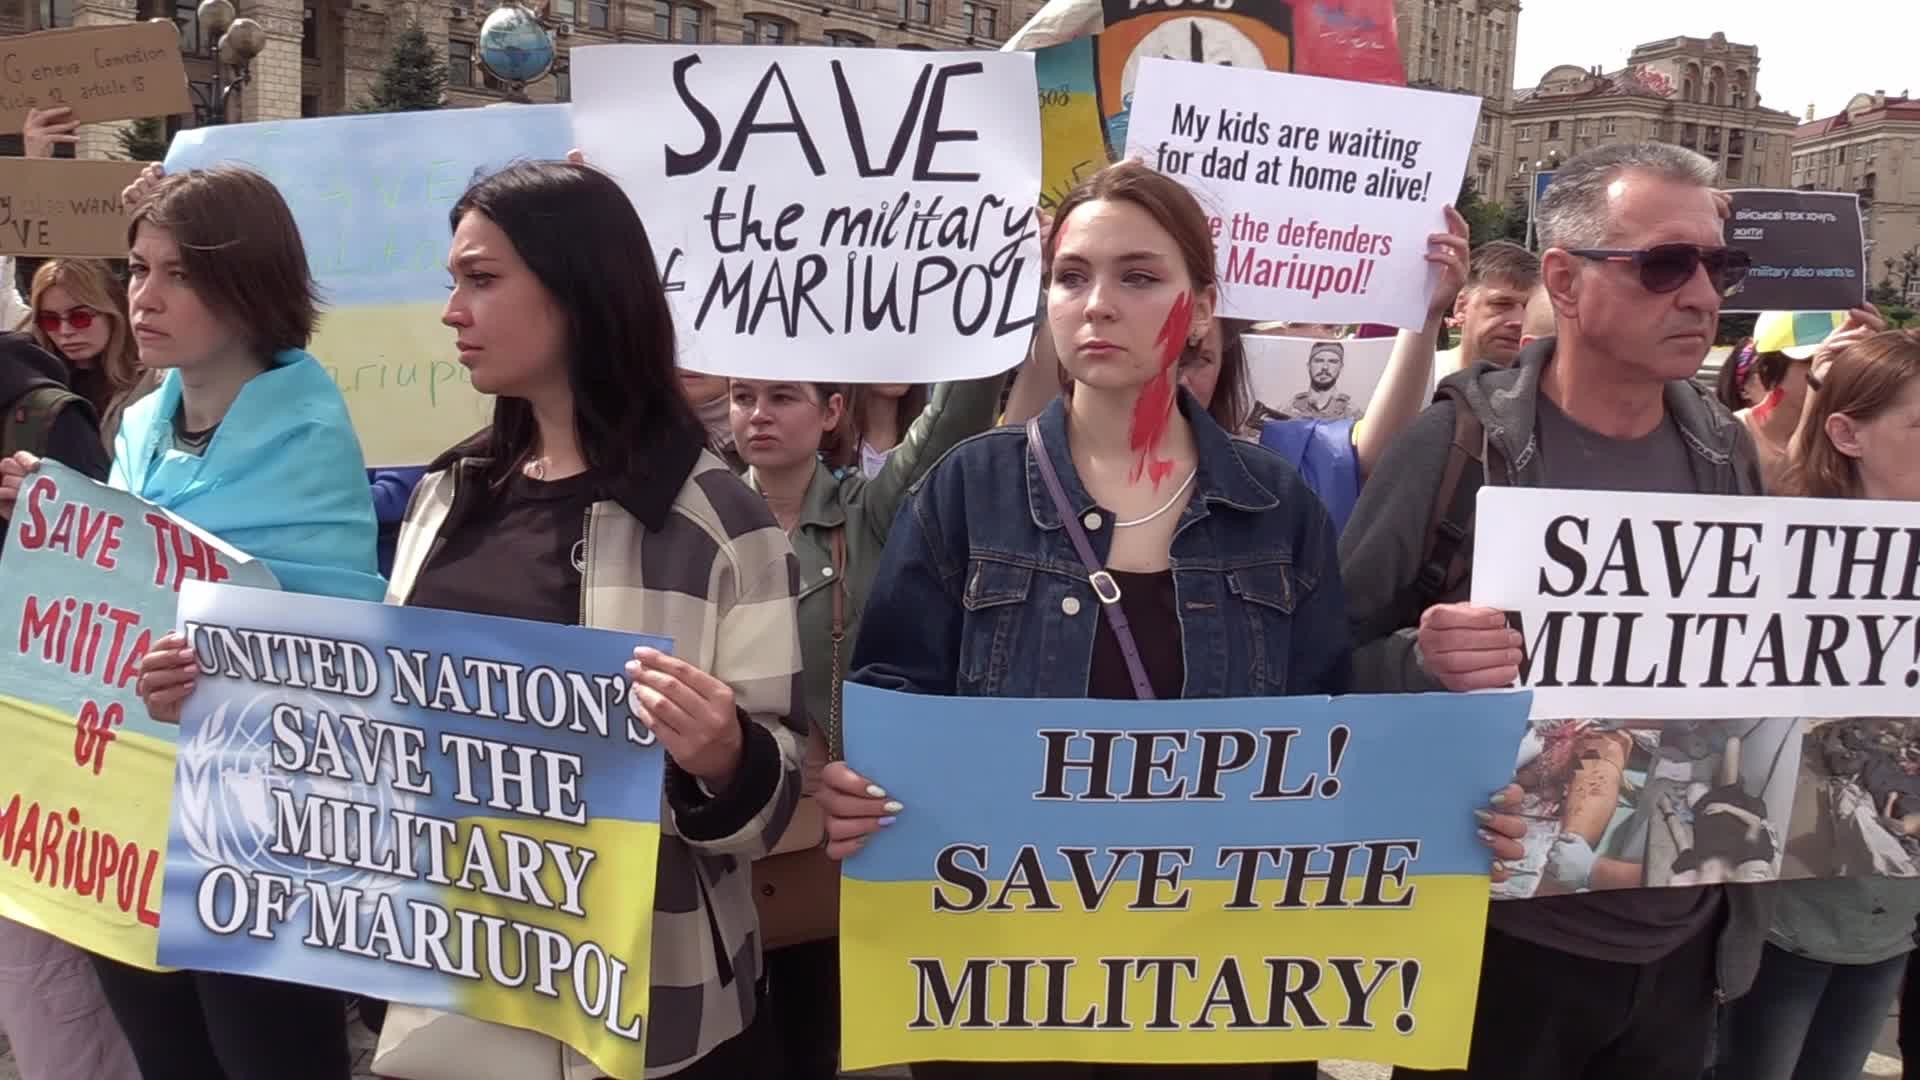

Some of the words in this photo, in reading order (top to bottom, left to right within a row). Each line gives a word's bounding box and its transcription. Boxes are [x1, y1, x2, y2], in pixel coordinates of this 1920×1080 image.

[664, 53, 984, 181] SAVE
[1171, 103, 1211, 142] My
[1217, 109, 1270, 146] kids
[1278, 123, 1319, 151] are
[1328, 128, 1421, 169] waiting
[1157, 142, 1194, 174] for
[1201, 147, 1249, 181] dad
[1255, 156, 1282, 186] at
[1289, 156, 1356, 194] home
[1365, 167, 1432, 202] alive!
[704, 184, 805, 253] the
[820, 191, 1037, 278] military
[1232, 212, 1269, 243] the
[1277, 217, 1393, 256] defenders
[1224, 245, 1375, 299] Mariupol!
[19, 477, 124, 569] SAVE
[1538, 515, 1763, 598] SAVE
[185, 621, 379, 697] UNITED
[271, 703, 432, 796] SAVE
[441, 732, 588, 827] THE
[1032, 725, 1351, 802] HEPL!
[271, 789, 597, 917] MILITARY
[932, 842, 1193, 913] SAVE
[1217, 839, 1421, 910] THE
[197, 866, 293, 940] OF
[304, 881, 642, 1042] MARIUPOL
[908, 956, 1422, 1035] MILITARY!
